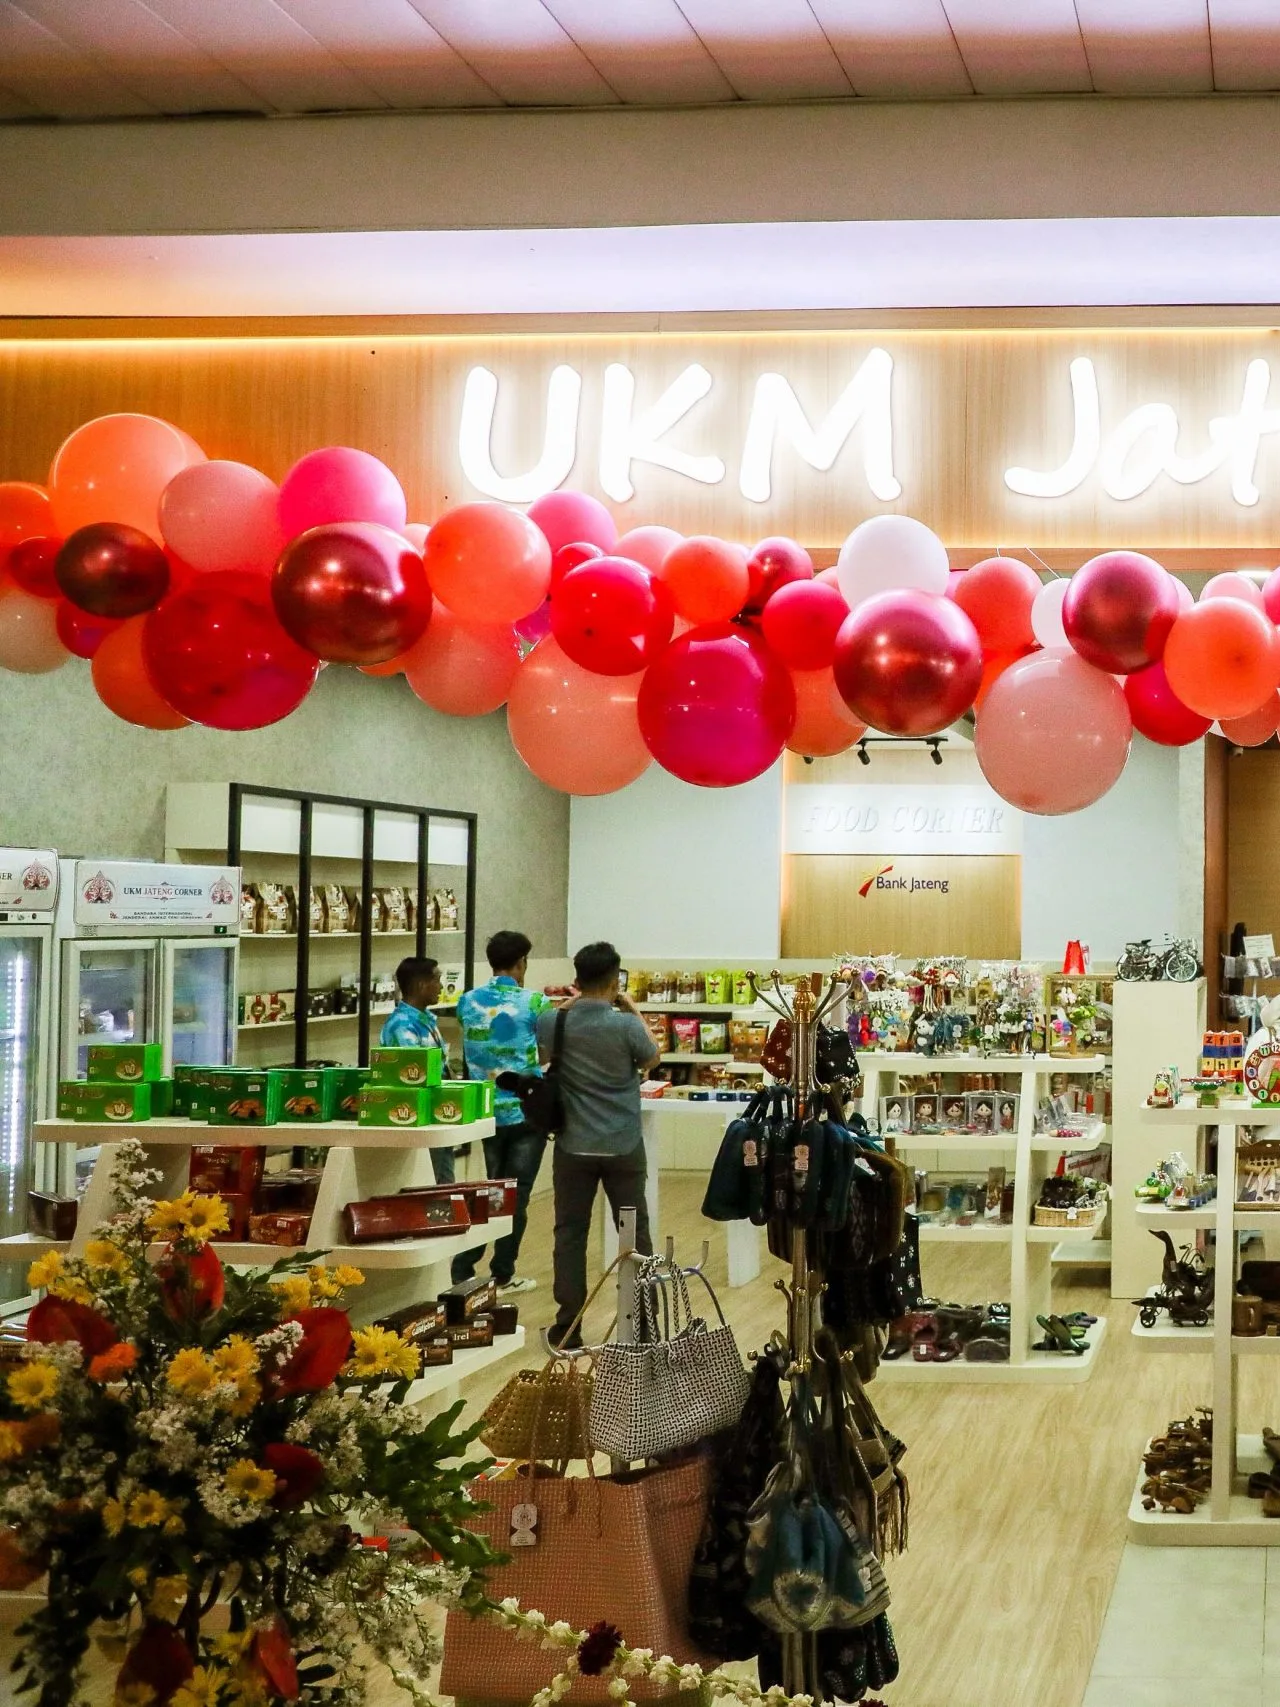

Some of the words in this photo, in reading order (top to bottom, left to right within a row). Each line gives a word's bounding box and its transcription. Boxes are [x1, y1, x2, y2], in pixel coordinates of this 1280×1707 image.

[458, 347, 897, 503] UKM
[802, 806, 880, 833] FOOD
[892, 806, 1004, 834] CORNER
[124, 887, 142, 895] UKM
[144, 887, 173, 895] JATENG
[174, 888, 203, 896] CORNER
[876, 877, 908, 889] Bank
[909, 877, 949, 893] Jateng
